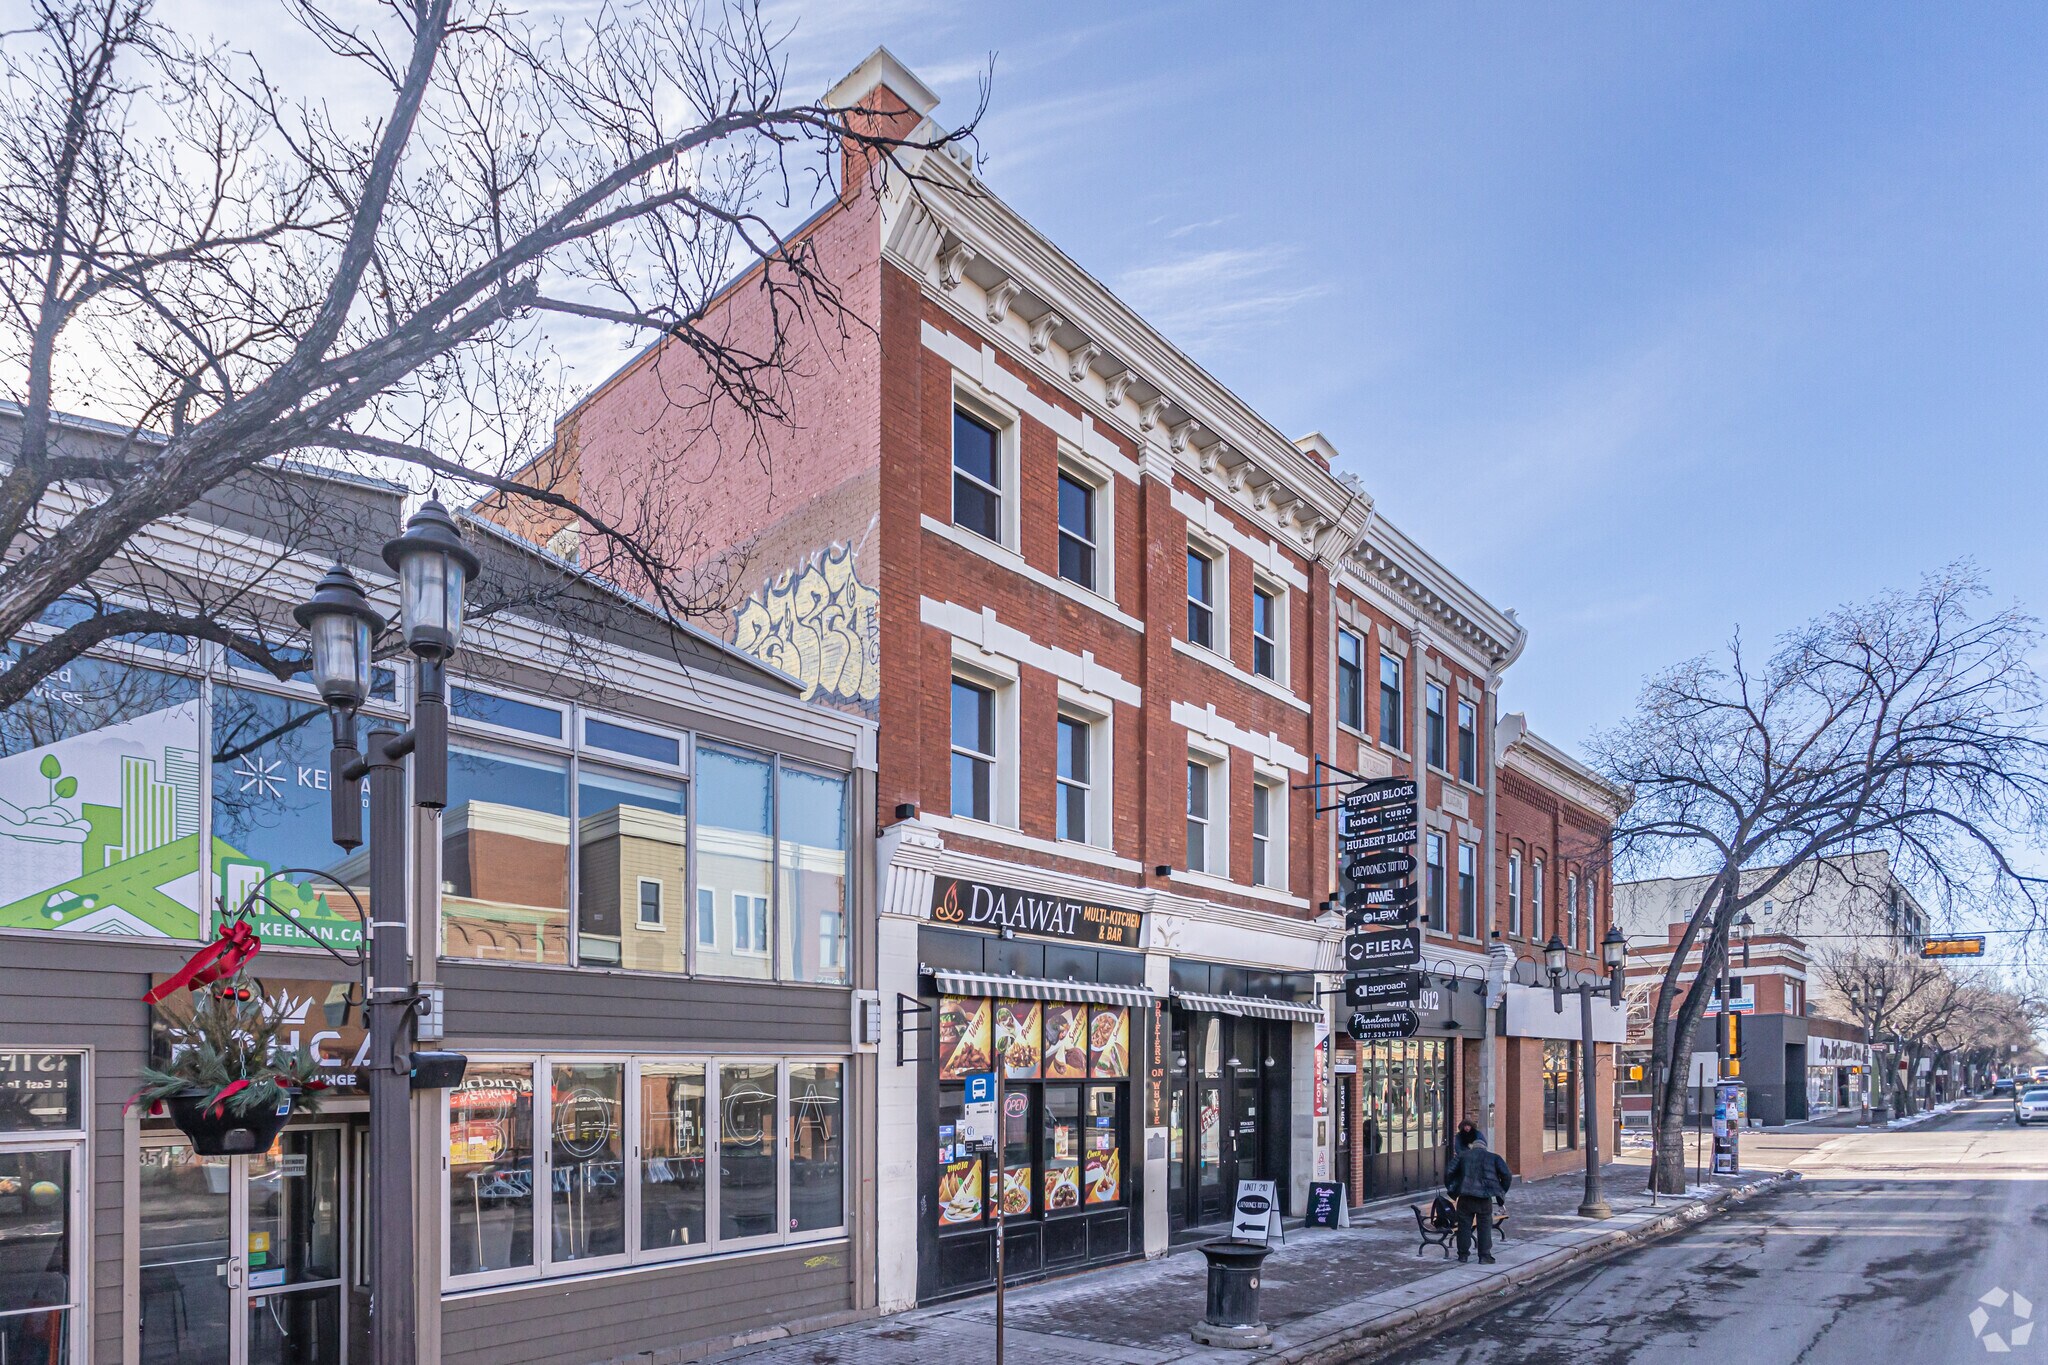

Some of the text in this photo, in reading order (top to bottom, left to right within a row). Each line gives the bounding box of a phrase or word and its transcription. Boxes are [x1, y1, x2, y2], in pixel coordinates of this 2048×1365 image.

[1347, 785, 1414, 807] TIPTON BLOCK
[1350, 815, 1378, 828] kobot
[1385, 807, 1412, 819] CURIO
[1346, 830, 1417, 850] HULBERT BLOCK
[1352, 860, 1409, 878] LAZYBONES TATTOO
[967, 885, 1082, 935] DAAWAT
[1083, 906, 1141, 929] MULTI-KITCHEN
[1098, 926, 1122, 942] & BAR
[1366, 937, 1414, 954] FIERA
[1368, 981, 1407, 993] approach
[1419, 989, 1439, 1010] 1912
[968, 1010, 985, 1038] Wings
[1354, 1013, 1390, 1026] Phantom
[1151, 1068, 1164, 1077] ON
[1005, 1098, 1027, 1111] OPEN
[1152, 1080, 1161, 1125] WHYTE
[1243, 1182, 1258, 1191] UNIT
